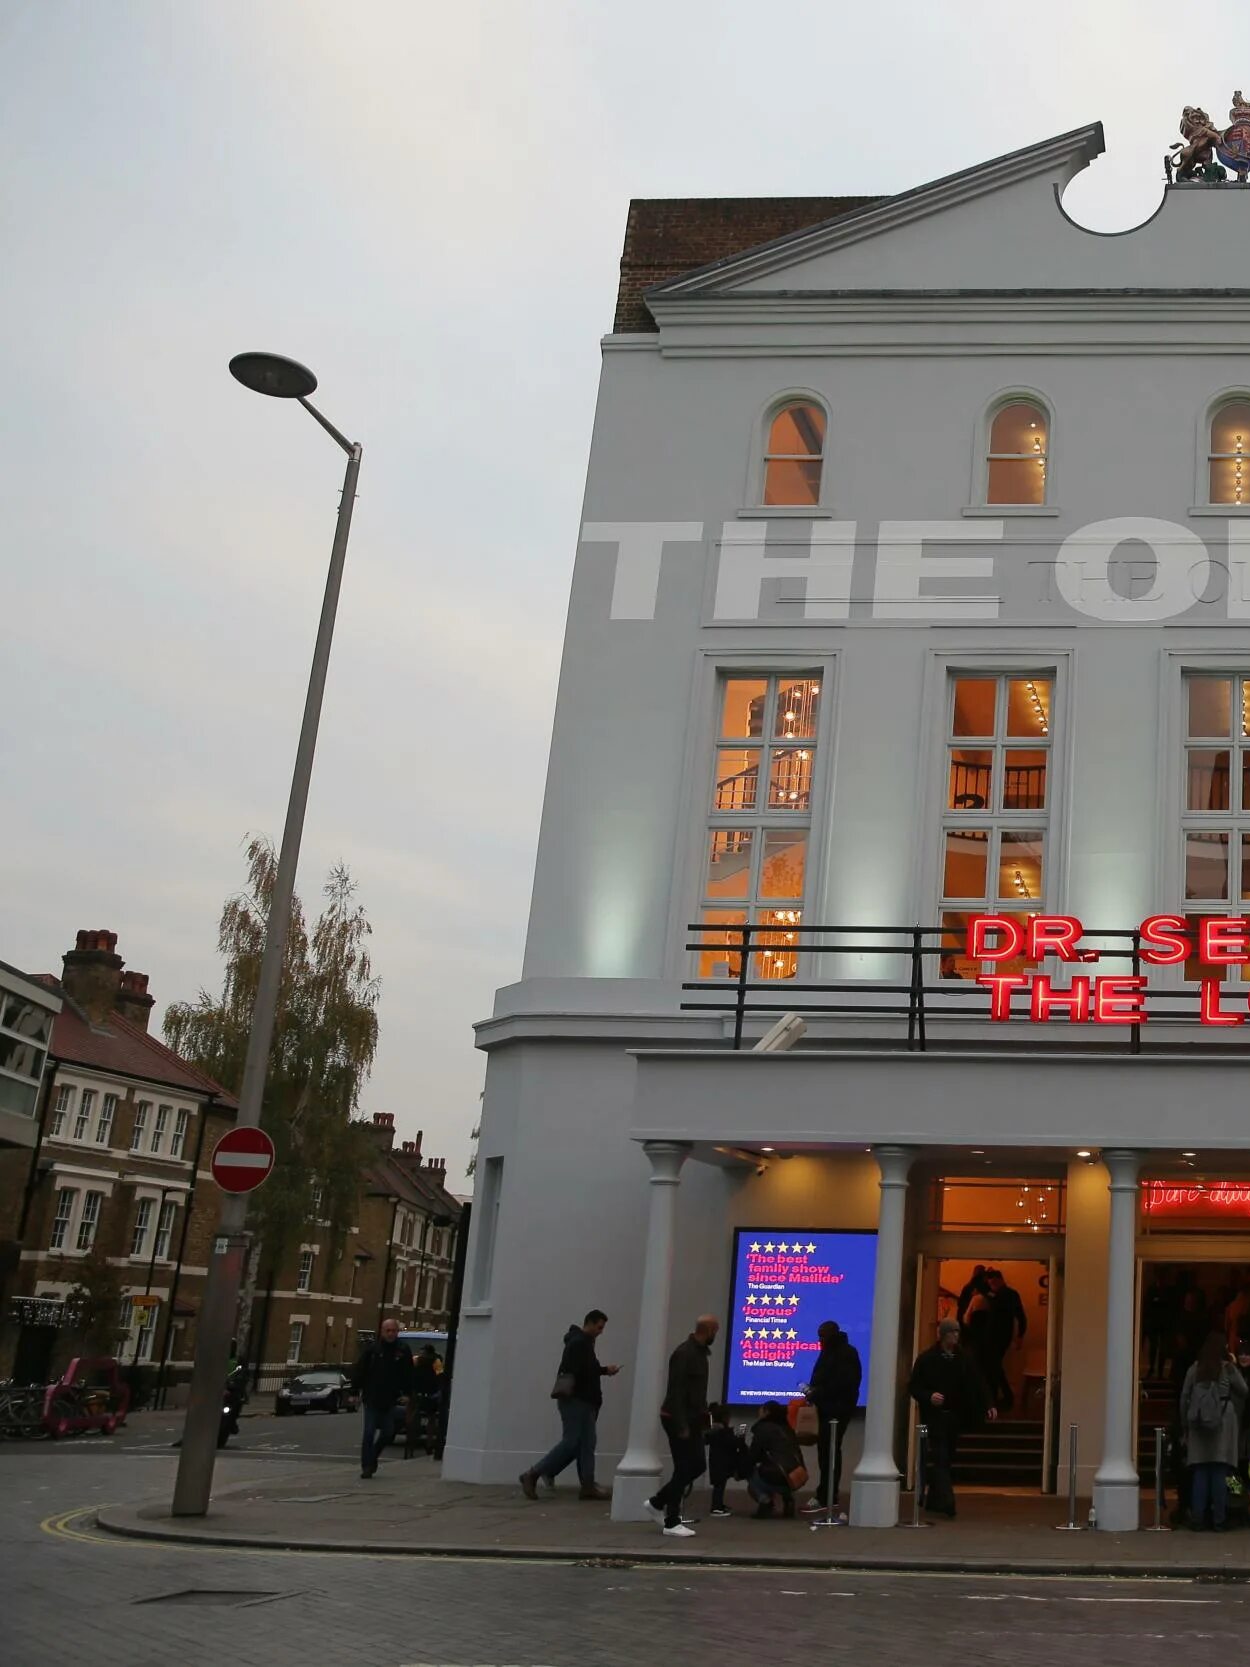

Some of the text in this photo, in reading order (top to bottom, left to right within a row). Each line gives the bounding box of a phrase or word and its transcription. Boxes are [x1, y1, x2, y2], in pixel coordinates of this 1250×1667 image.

[581, 521, 1004, 620] THE
[966, 914, 1099, 963] DR.
[976, 974, 1148, 1024] THE
[777, 1254, 808, 1263] best
[749, 1264, 829, 1274] family show
[748, 1272, 786, 1282] since
[754, 1340, 822, 1350] theatrical
[773, 1360, 795, 1368] Sunday
